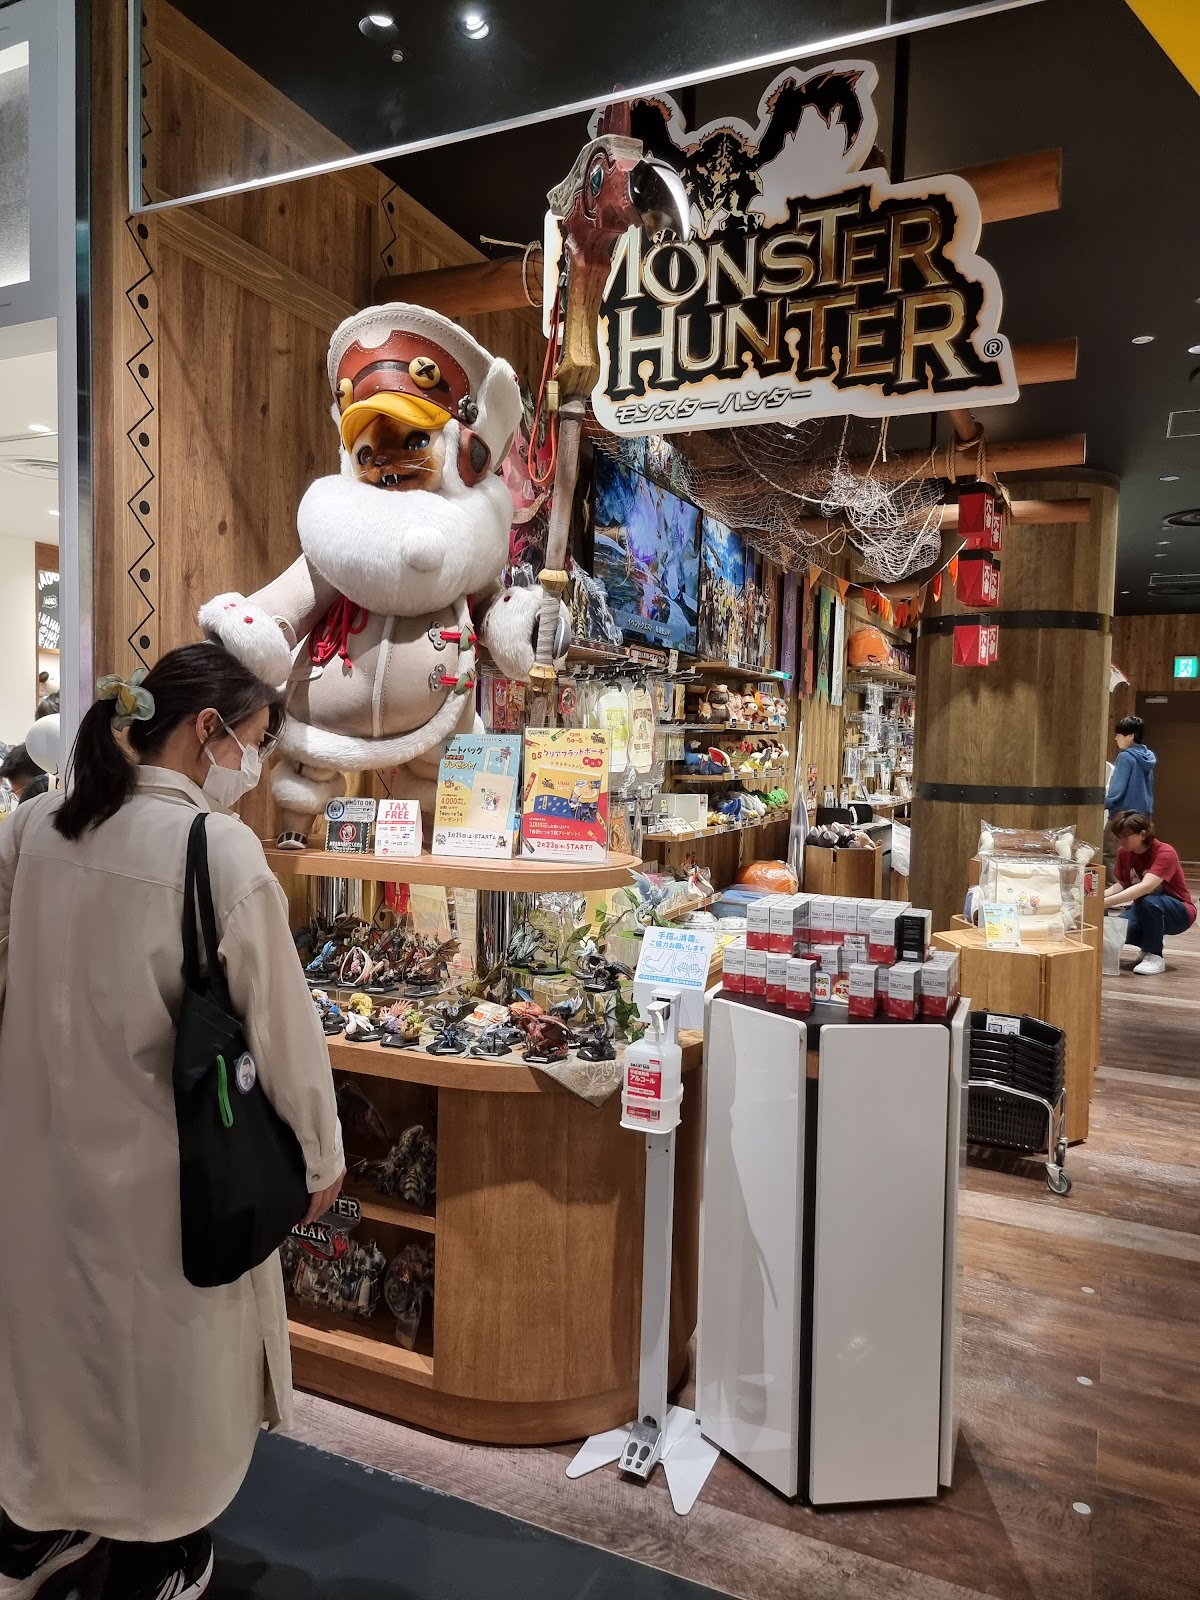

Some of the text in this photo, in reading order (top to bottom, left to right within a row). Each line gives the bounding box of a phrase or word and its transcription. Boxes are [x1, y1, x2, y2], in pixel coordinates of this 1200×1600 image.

[614, 287, 981, 391] HUNTER
[615, 387, 813, 424] モンスターハンター
[444, 745, 484, 755] トートバッグ
[531, 751, 543, 760] B5
[388, 802, 409, 811] TAX
[384, 811, 410, 819] FREE
[657, 931, 700, 943] 手指の消毒に
[649, 940, 706, 952] ご協力お願いします
[629, 1075, 656, 1084] アルコール
[332, 1198, 358, 1218] TER
